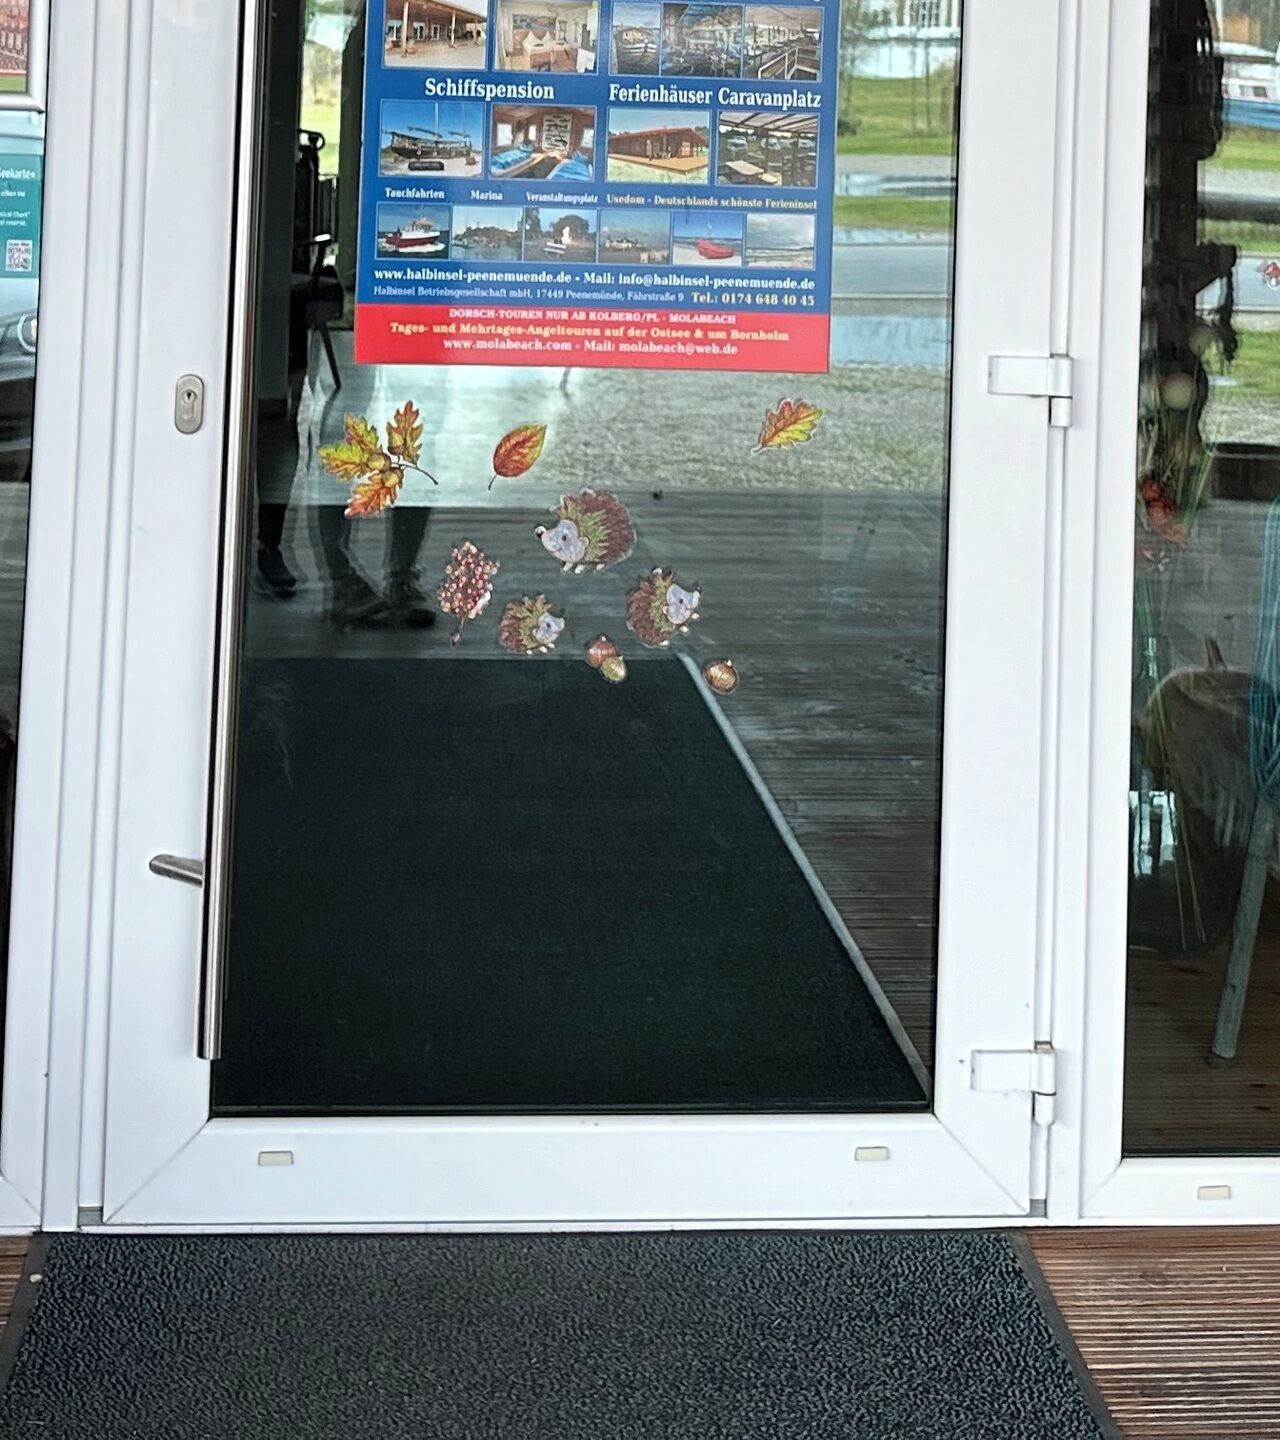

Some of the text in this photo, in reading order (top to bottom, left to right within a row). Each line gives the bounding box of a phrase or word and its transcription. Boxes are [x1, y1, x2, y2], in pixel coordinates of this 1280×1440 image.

[425, 77, 554, 101] Schiffspension
[609, 83, 821, 109] Ferienhäuser Caravanplatz
[385, 187, 444, 199] Tauchfahrten
[471, 190, 503, 200] Marina
[607, 195, 645, 205] Usedom
[655, 195, 718, 207] Deutschlands
[721, 195, 762, 208] schönste
[765, 198, 817, 209] Ferieninsel
[374, 268, 571, 284] www.halbinsel-peenemuende.de
[584, 272, 615, 285] Mail:
[619, 273, 815, 290] info@halbinsel-peenemuende.de
[374, 286, 415, 296] Halbinsel
[418, 287, 506, 298] Betriebsgesellschaft
[537, 289, 563, 298] 17449
[627, 291, 676, 301] Fährstraße
[678, 293, 684, 302] 9
[691, 292, 814, 306] Tel.: 0174 648 40 45
[449, 308, 543, 319] DORSCH-TOUREN
[546, 311, 568, 320] NUR
[571, 311, 586, 320] AB
[589, 311, 659, 323] KOLBERG/PL
[669, 313, 735, 324] MOLABEACH
[390, 322, 789, 341] Tages- und Mehrtages-Angeltouren auf der Ostsee & um Bornholm
[443, 339, 571, 351] www.molabeach.com
[584, 340, 615, 352] Mail:
[619, 341, 737, 355] molabeach@web.de
